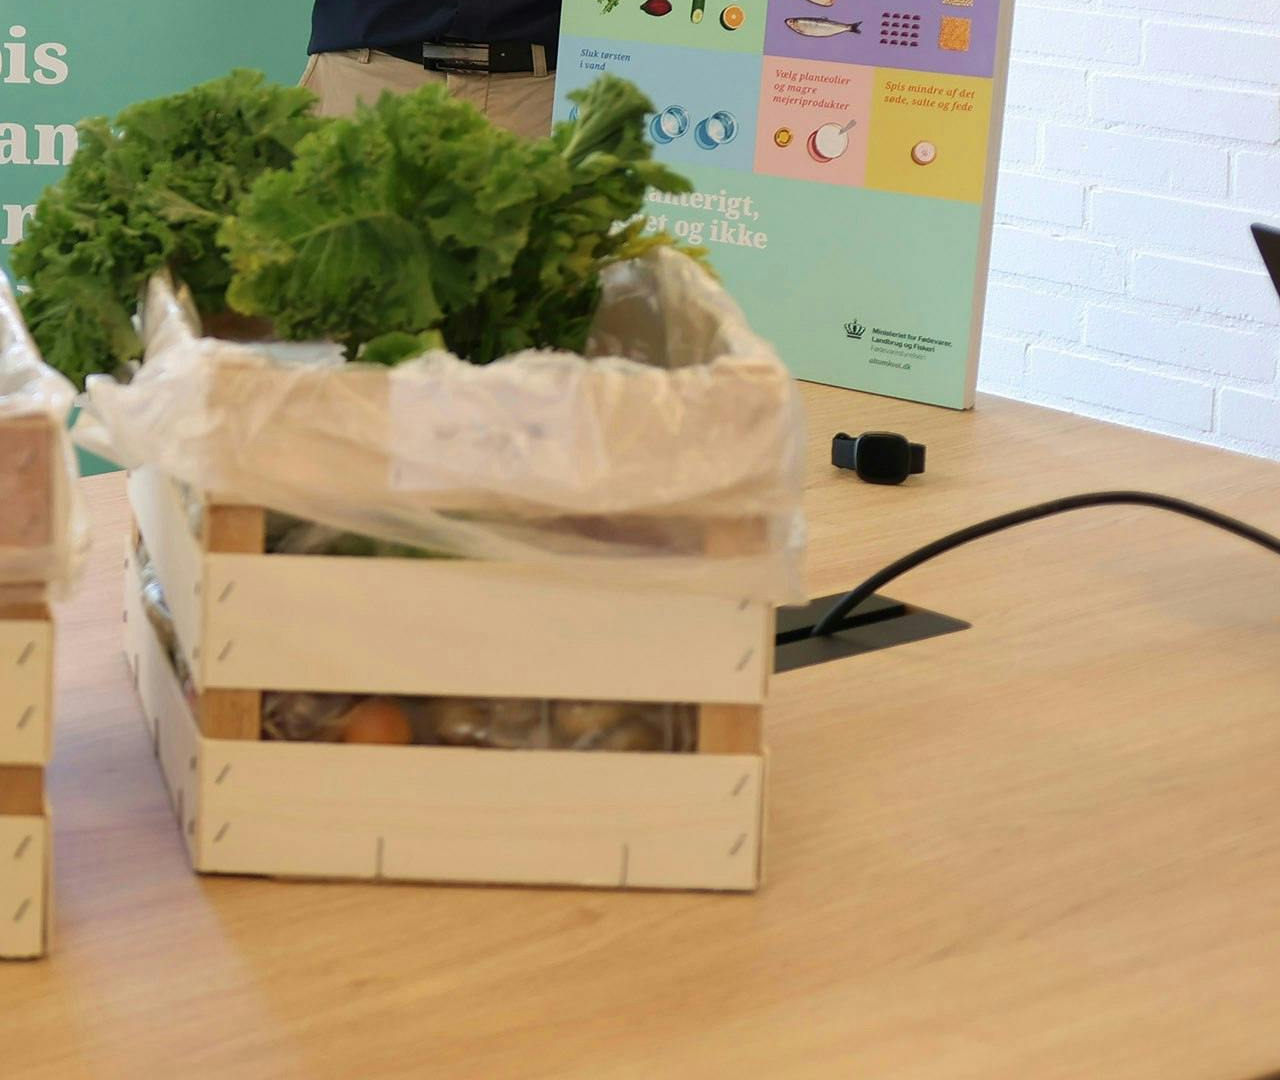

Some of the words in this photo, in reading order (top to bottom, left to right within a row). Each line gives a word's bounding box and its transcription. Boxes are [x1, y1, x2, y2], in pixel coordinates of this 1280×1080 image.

[580, 48, 599, 58] Sluk
[600, 51, 631, 62] tørsten
[585, 62, 606, 71] vand
[776, 69, 798, 81] Vælg
[798, 72, 851, 85] planteolier
[773, 82, 786, 93] og
[786, 84, 818, 95] magre
[885, 80, 905, 92] Spis
[908, 83, 944, 95] mindre
[946, 87, 959, 99] af
[959, 88, 976, 99] det
[772, 95, 850, 111] mejeriprodukter
[911, 98, 936, 108] salte
[938, 101, 950, 111] og
[950, 100, 974, 112] fede
[674, 220, 705, 245] og
[709, 219, 769, 249] ikke
[872, 327, 906, 339] Ministeriet
[907, 333, 917, 341] for
[871, 336, 903, 348] Landbrug
[903, 341, 913, 350] og
[913, 342, 935, 353] Fiskeri
